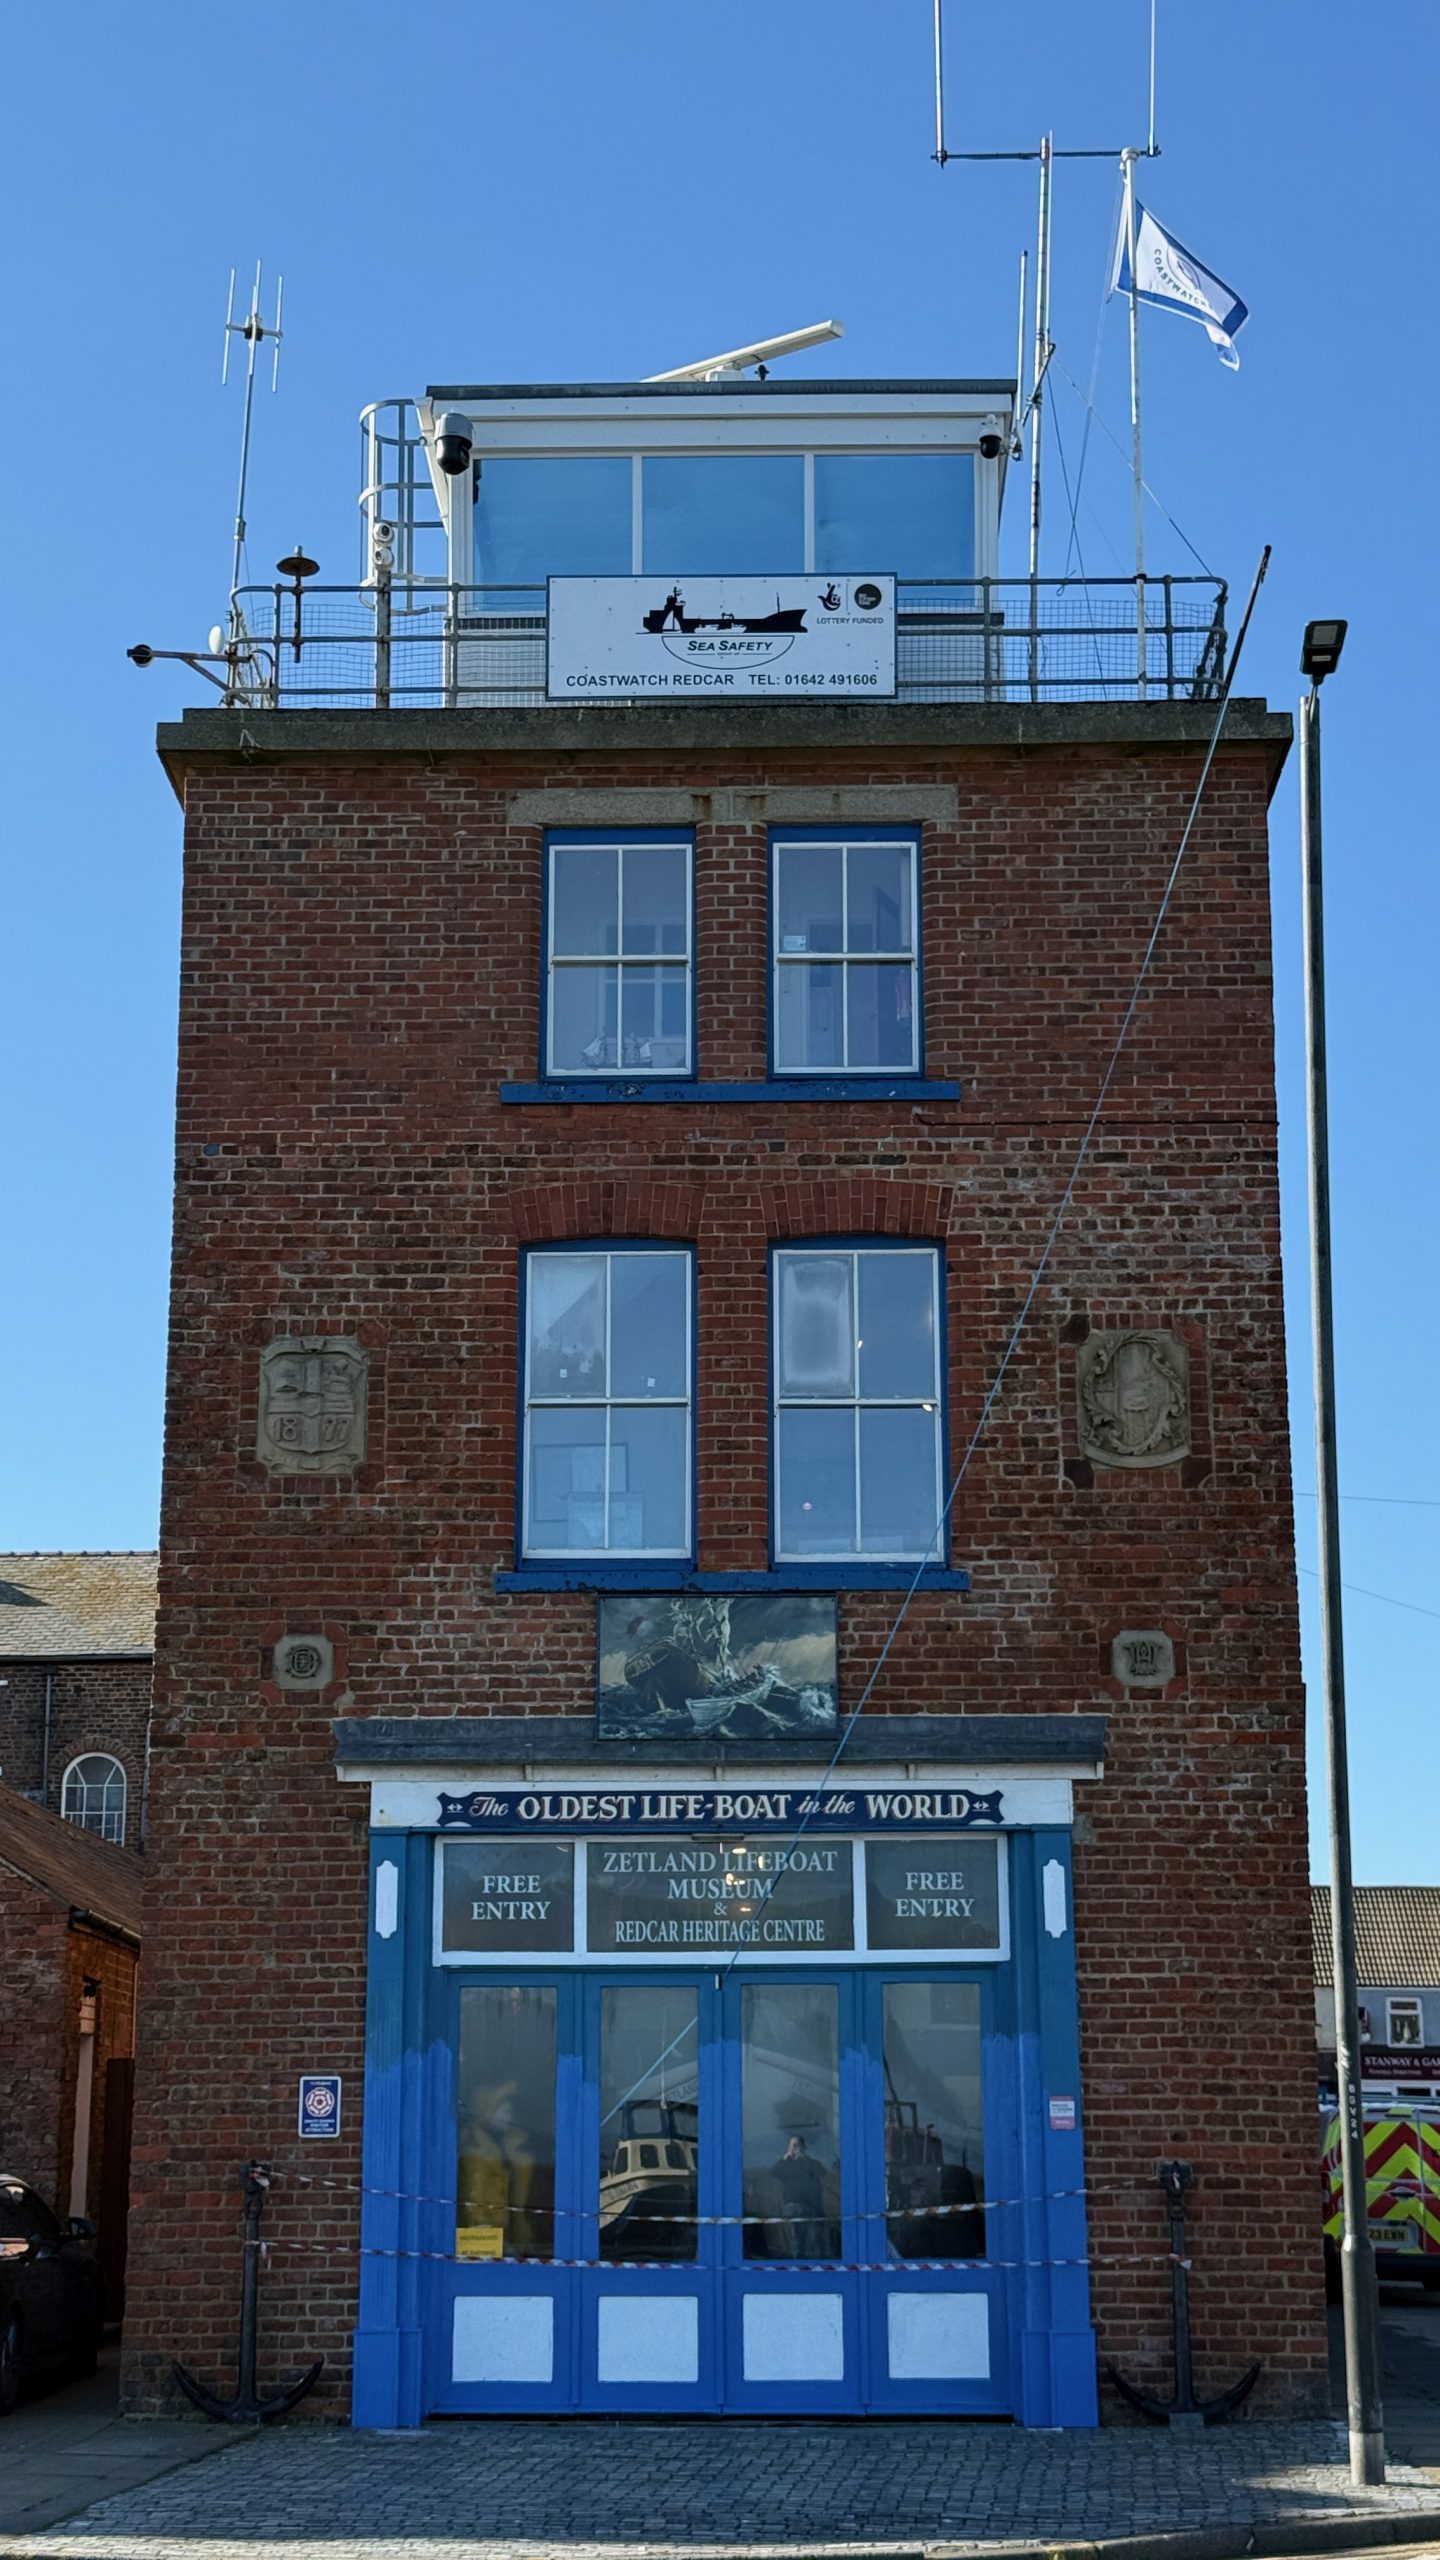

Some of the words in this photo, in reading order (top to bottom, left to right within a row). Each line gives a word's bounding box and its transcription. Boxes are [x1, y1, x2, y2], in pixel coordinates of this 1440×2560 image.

[1154, 249, 1206, 307] COASTWATCH
[687, 640, 715, 651] SEA
[718, 640, 773, 651] SAFETY
[566, 674, 668, 687] COASTWATCH
[673, 674, 734, 685] REDCAR
[749, 674, 781, 686] TEL:
[785, 674, 825, 685] 01642
[829, 674, 878, 685] 491606
[469, 1796, 509, 1817] The
[518, 1796, 636, 1820] OLDEST
[640, 1794, 791, 1819] LIFE-BOAT
[795, 1794, 822, 1814] in
[823, 1793, 855, 1814] the
[864, 1794, 970, 1819] WORLD
[603, 1852, 716, 1873] ZETLAND
[722, 1851, 838, 1872] LIFEBOAT
[482, 1875, 541, 1894] FREE
[667, 1878, 774, 1899] MUSEUM
[905, 1872, 965, 1891] FREE
[471, 1901, 551, 1920] ENTRY
[714, 1903, 727, 1916] &
[895, 1899, 975, 1917] ENTRY
[615, 1920, 679, 1943] REDCAR
[682, 1920, 760, 1943] HERITAGE
[763, 1919, 825, 1942] CENTRE
[1364, 2056, 1411, 2067] STANWAY
